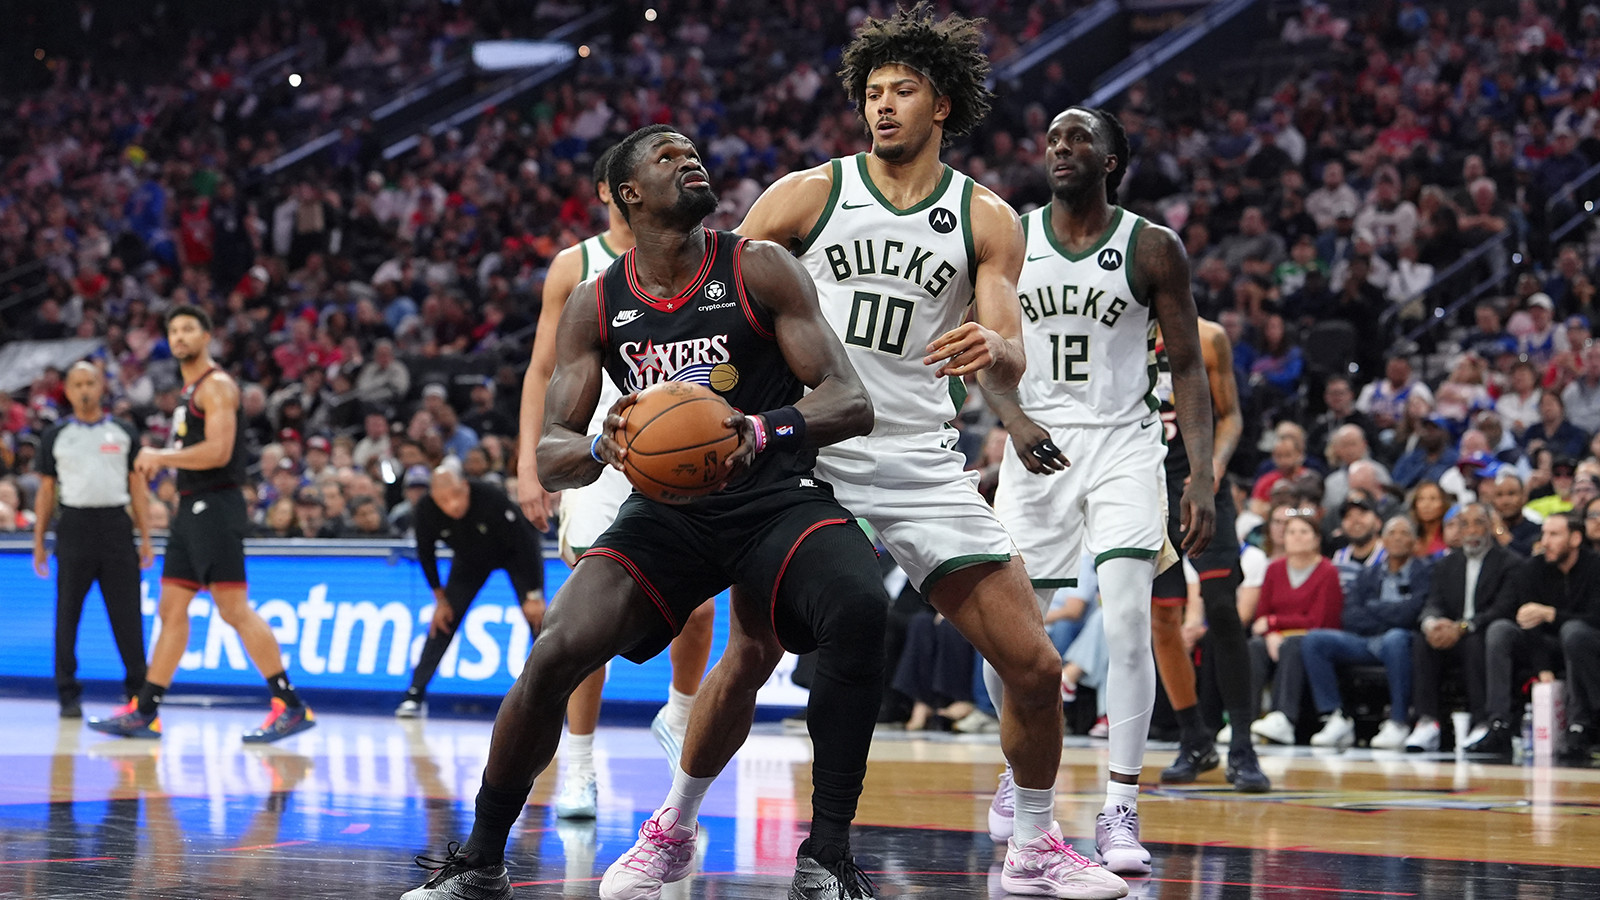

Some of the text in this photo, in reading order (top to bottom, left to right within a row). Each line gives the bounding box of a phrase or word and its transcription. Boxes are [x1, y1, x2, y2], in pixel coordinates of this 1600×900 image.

[824, 239, 958, 298] BUCKS
[616, 309, 639, 321] NIKE
[698, 301, 736, 312] crypto.com
[844, 290, 915, 356] 00
[1018, 284, 1128, 328] BUCKS
[1049, 334, 1089, 382] 12
